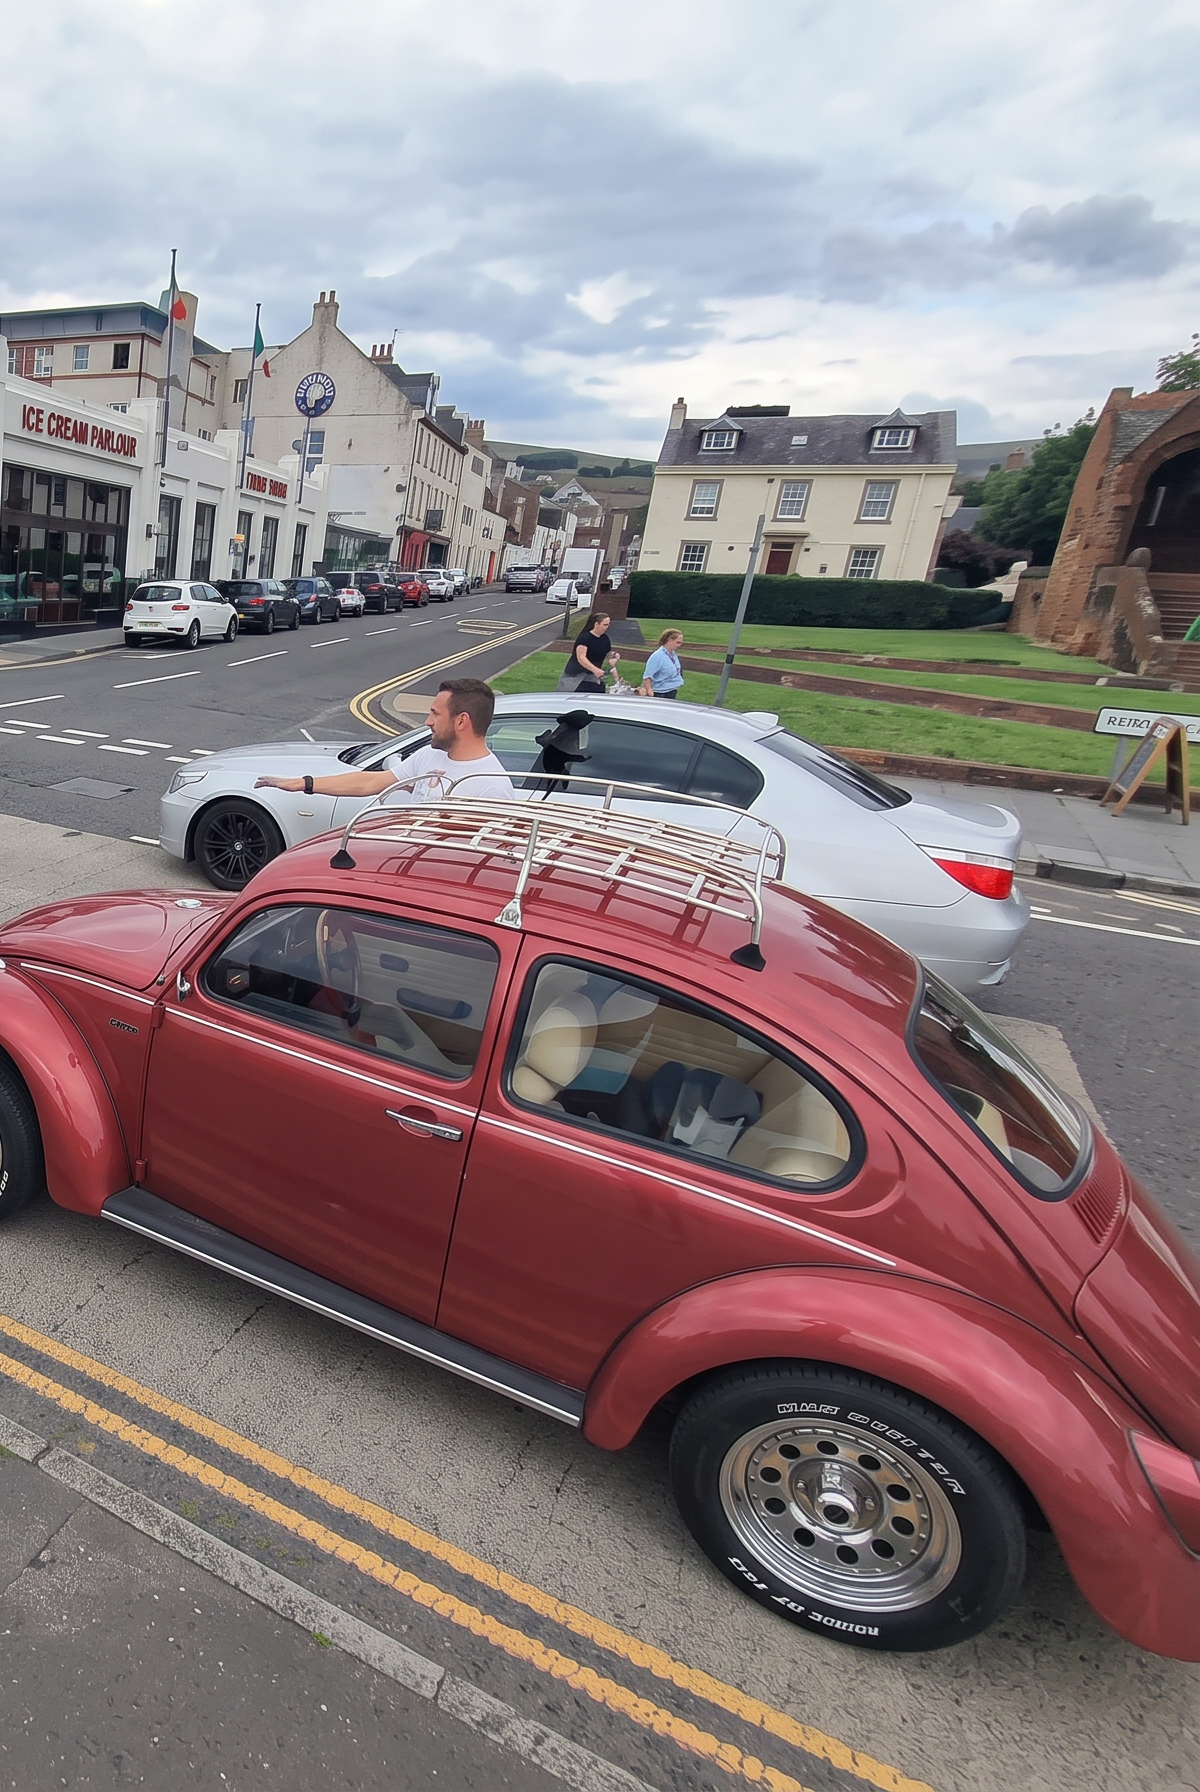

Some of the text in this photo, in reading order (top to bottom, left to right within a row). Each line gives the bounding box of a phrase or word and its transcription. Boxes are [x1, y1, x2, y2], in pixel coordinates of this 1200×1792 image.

[21, 404, 138, 458] ICE CREAM PARLOUR
